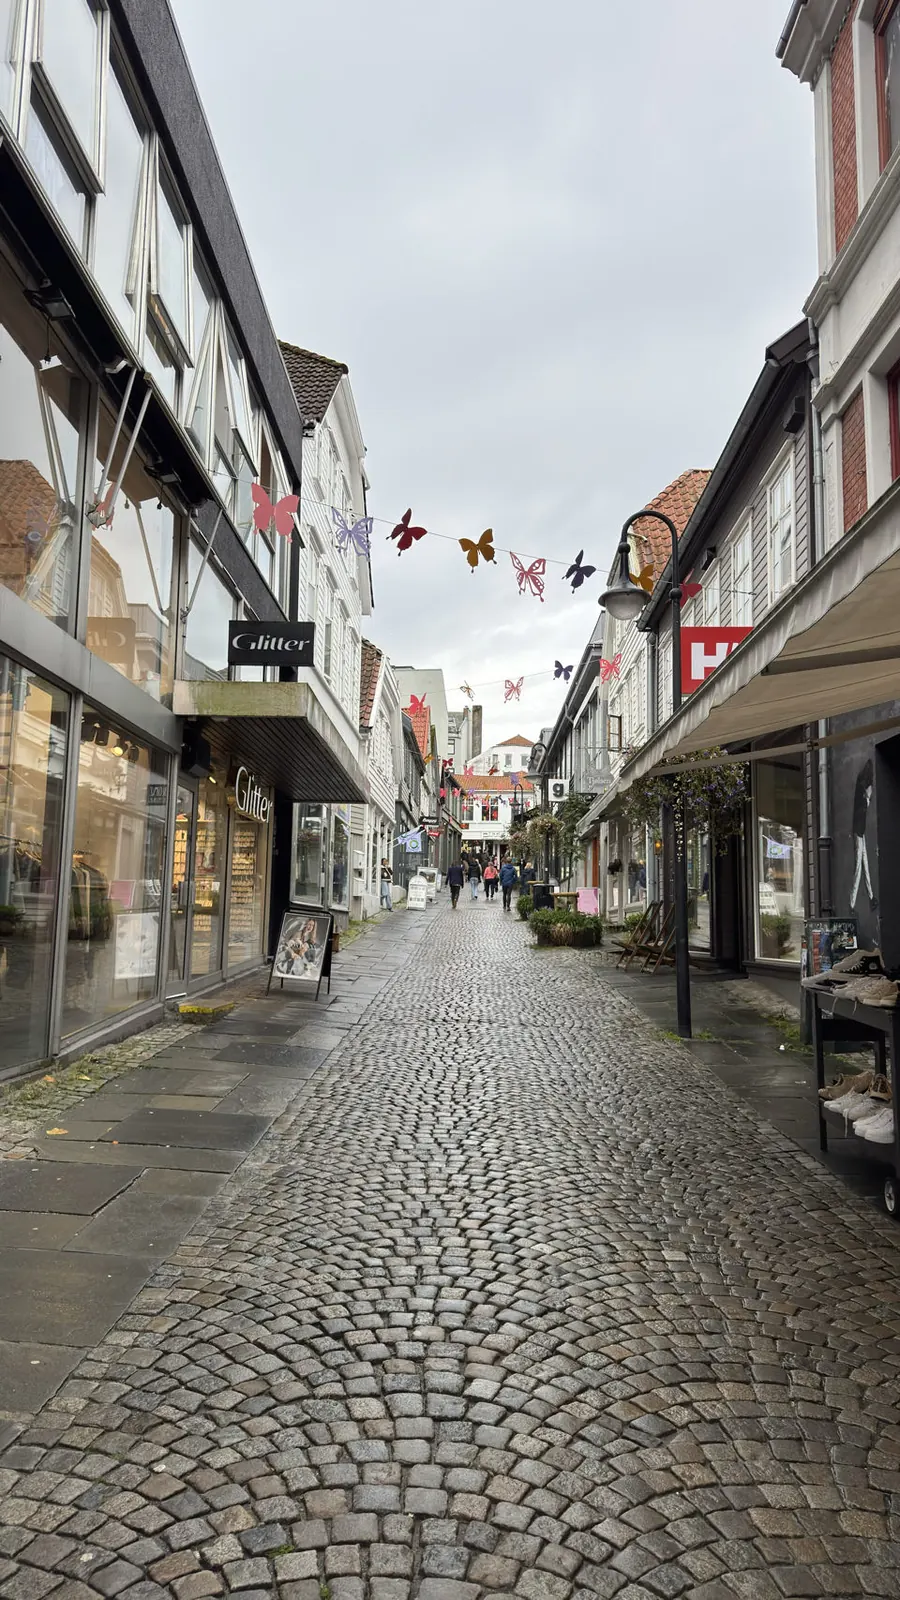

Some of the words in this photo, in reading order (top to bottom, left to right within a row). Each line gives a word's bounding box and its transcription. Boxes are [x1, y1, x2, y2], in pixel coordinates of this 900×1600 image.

[232, 633, 310, 651] Glitter
[691, 642, 739, 680] H
[235, 766, 273, 823] Glitter
[552, 783, 565, 798] g
